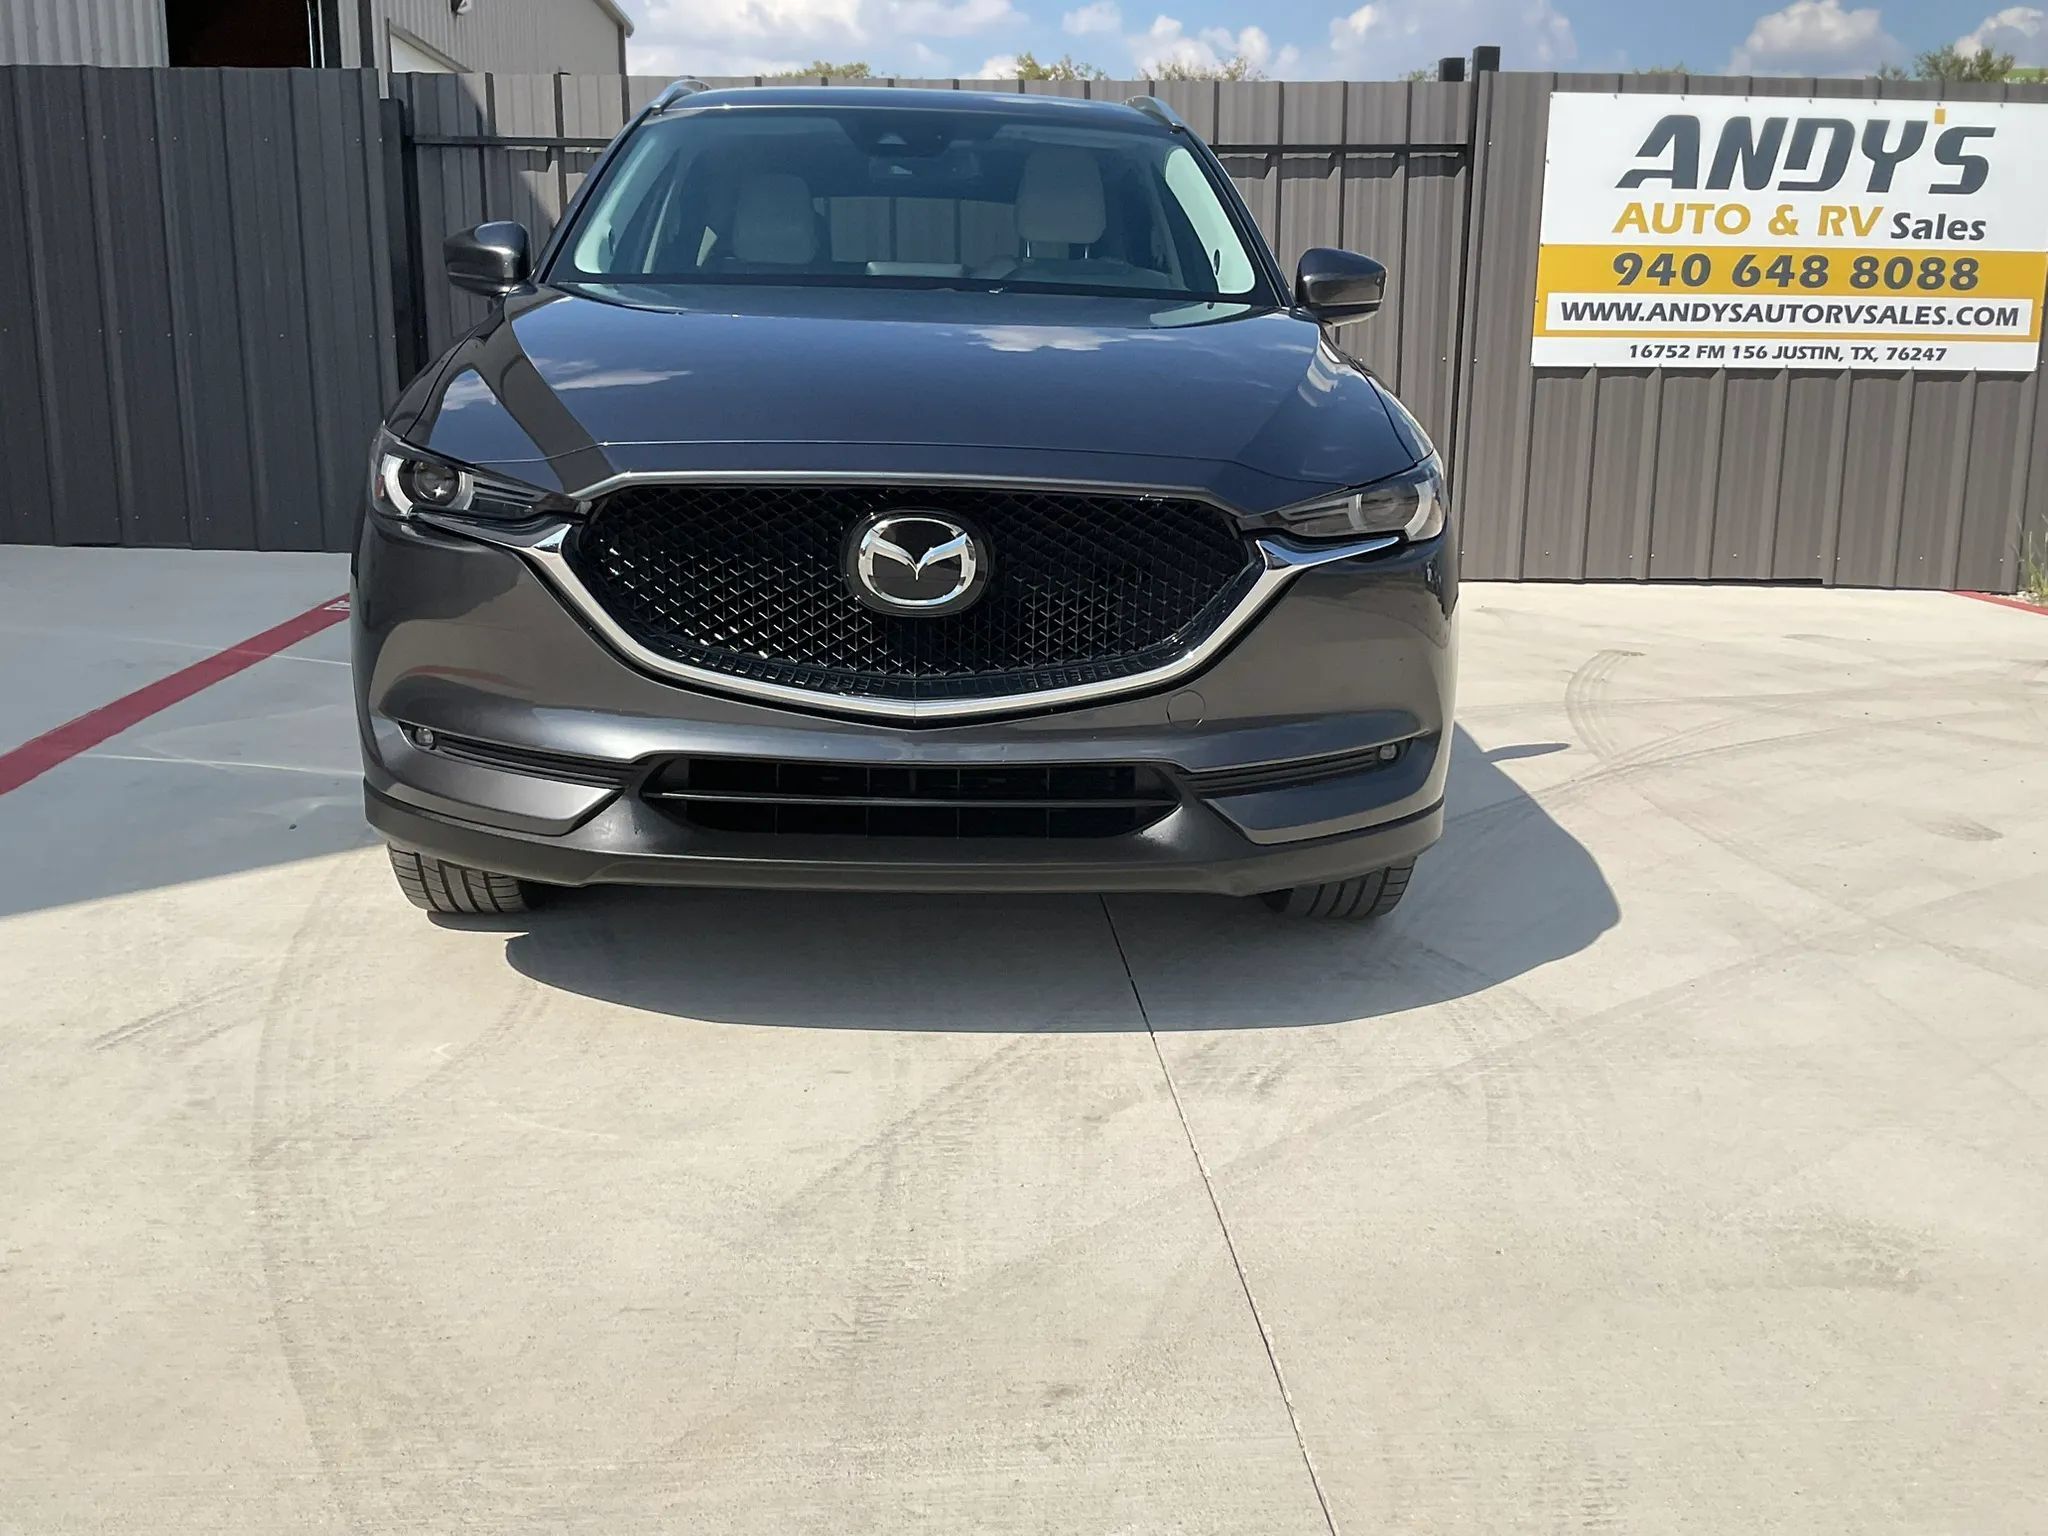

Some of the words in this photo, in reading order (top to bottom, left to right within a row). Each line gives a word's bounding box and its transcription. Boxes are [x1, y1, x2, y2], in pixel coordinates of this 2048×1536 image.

[1615, 109, 1996, 195] ANDY'S
[1611, 202, 1751, 236] AUTO
[1767, 204, 1799, 236] &
[1817, 205, 1883, 237] RV
[1890, 212, 1986, 241] Sales
[1613, 252, 1711, 287] 940
[1732, 254, 1829, 289] 648
[1850, 256, 1979, 290] 8088
[1561, 302, 2019, 326] WWW.ANDYSAUTORVSALES.COM
[1629, 344, 1690, 359] 16752
[1696, 345, 1725, 359] FM
[1732, 345, 1767, 360] 156
[1772, 346, 1844, 362] JUSTIN,
[1850, 347, 1879, 362] TX,
[1886, 347, 1947, 361] 76247
